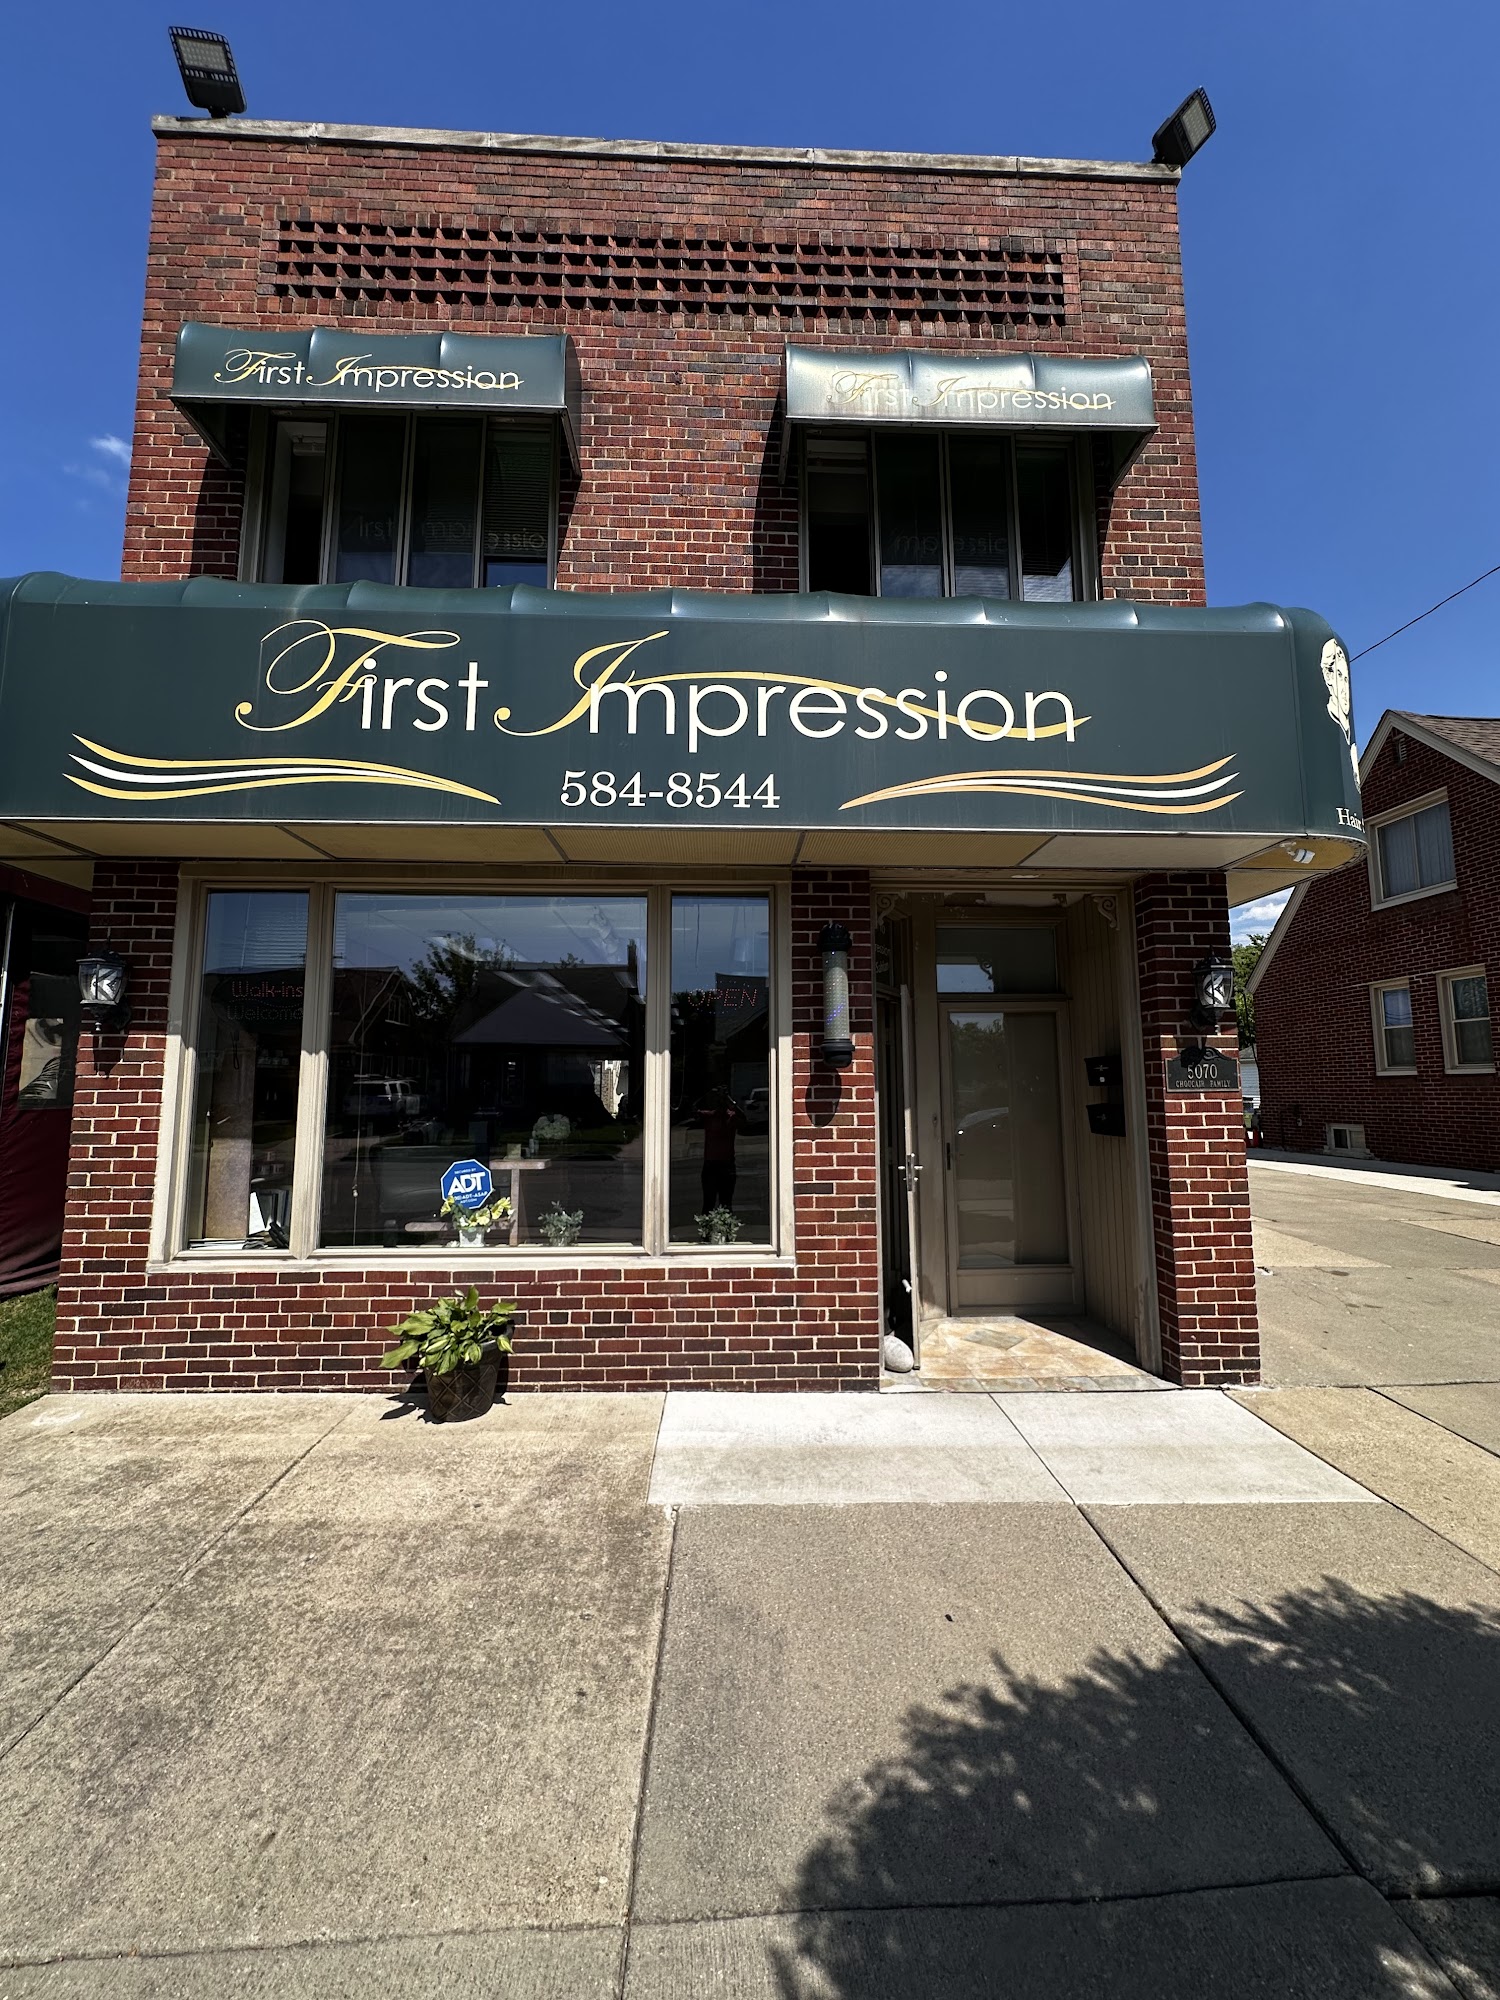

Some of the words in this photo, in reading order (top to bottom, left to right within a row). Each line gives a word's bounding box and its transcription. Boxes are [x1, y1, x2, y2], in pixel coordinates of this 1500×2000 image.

[214, 348, 305, 384] First
[306, 353, 524, 393] Impression
[827, 370, 910, 406] First
[912, 375, 1116, 413] Impression
[234, 618, 489, 732] First
[493, 630, 1091, 754] Impression
[560, 770, 780, 809] 584-8544
[231, 980, 304, 998] Walk-ins
[687, 988, 758, 1007] OPEN
[226, 1004, 304, 1021] Welcome
[1187, 1063, 1218, 1079] 5070
[1210, 1080, 1231, 1088] FAMILY
[447, 1171, 486, 1196] ADT
